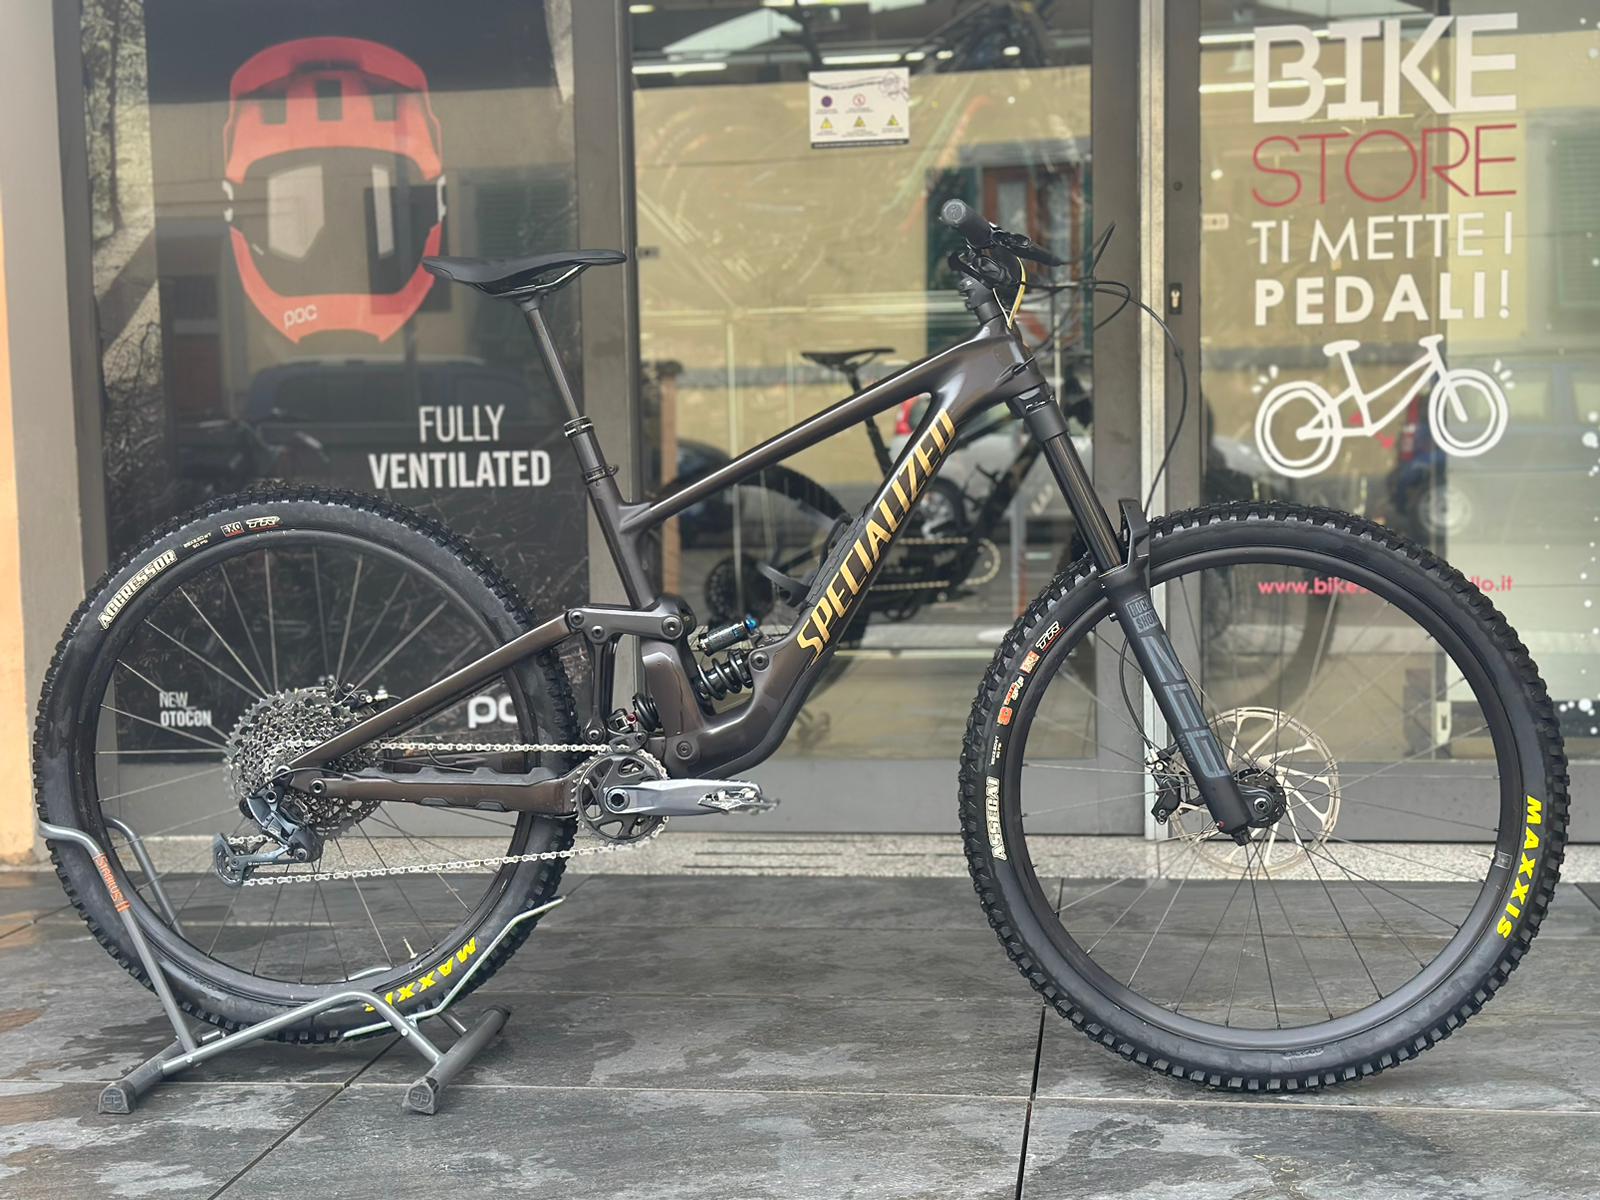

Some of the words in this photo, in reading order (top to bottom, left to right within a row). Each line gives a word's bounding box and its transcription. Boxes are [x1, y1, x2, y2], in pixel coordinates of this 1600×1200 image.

[1253, 12, 1518, 123] BIKE
[1252, 123, 1517, 207] STORE
[1252, 219, 1290, 264] TI
[1309, 211, 1484, 263] METTE
[1504, 211, 1513, 256] I
[1254, 269, 1511, 326] PEDALI!
[418, 404, 505, 443] FULLY
[368, 450, 551, 489] VENTILATED
[796, 407, 956, 669] SPECIALIZED
[98, 550, 178, 630] AGGRESSOR
[160, 709, 212, 727] OTOCON
[985, 775, 1008, 861] ASSEGAI
[1496, 794, 1543, 940] MAXXIS
